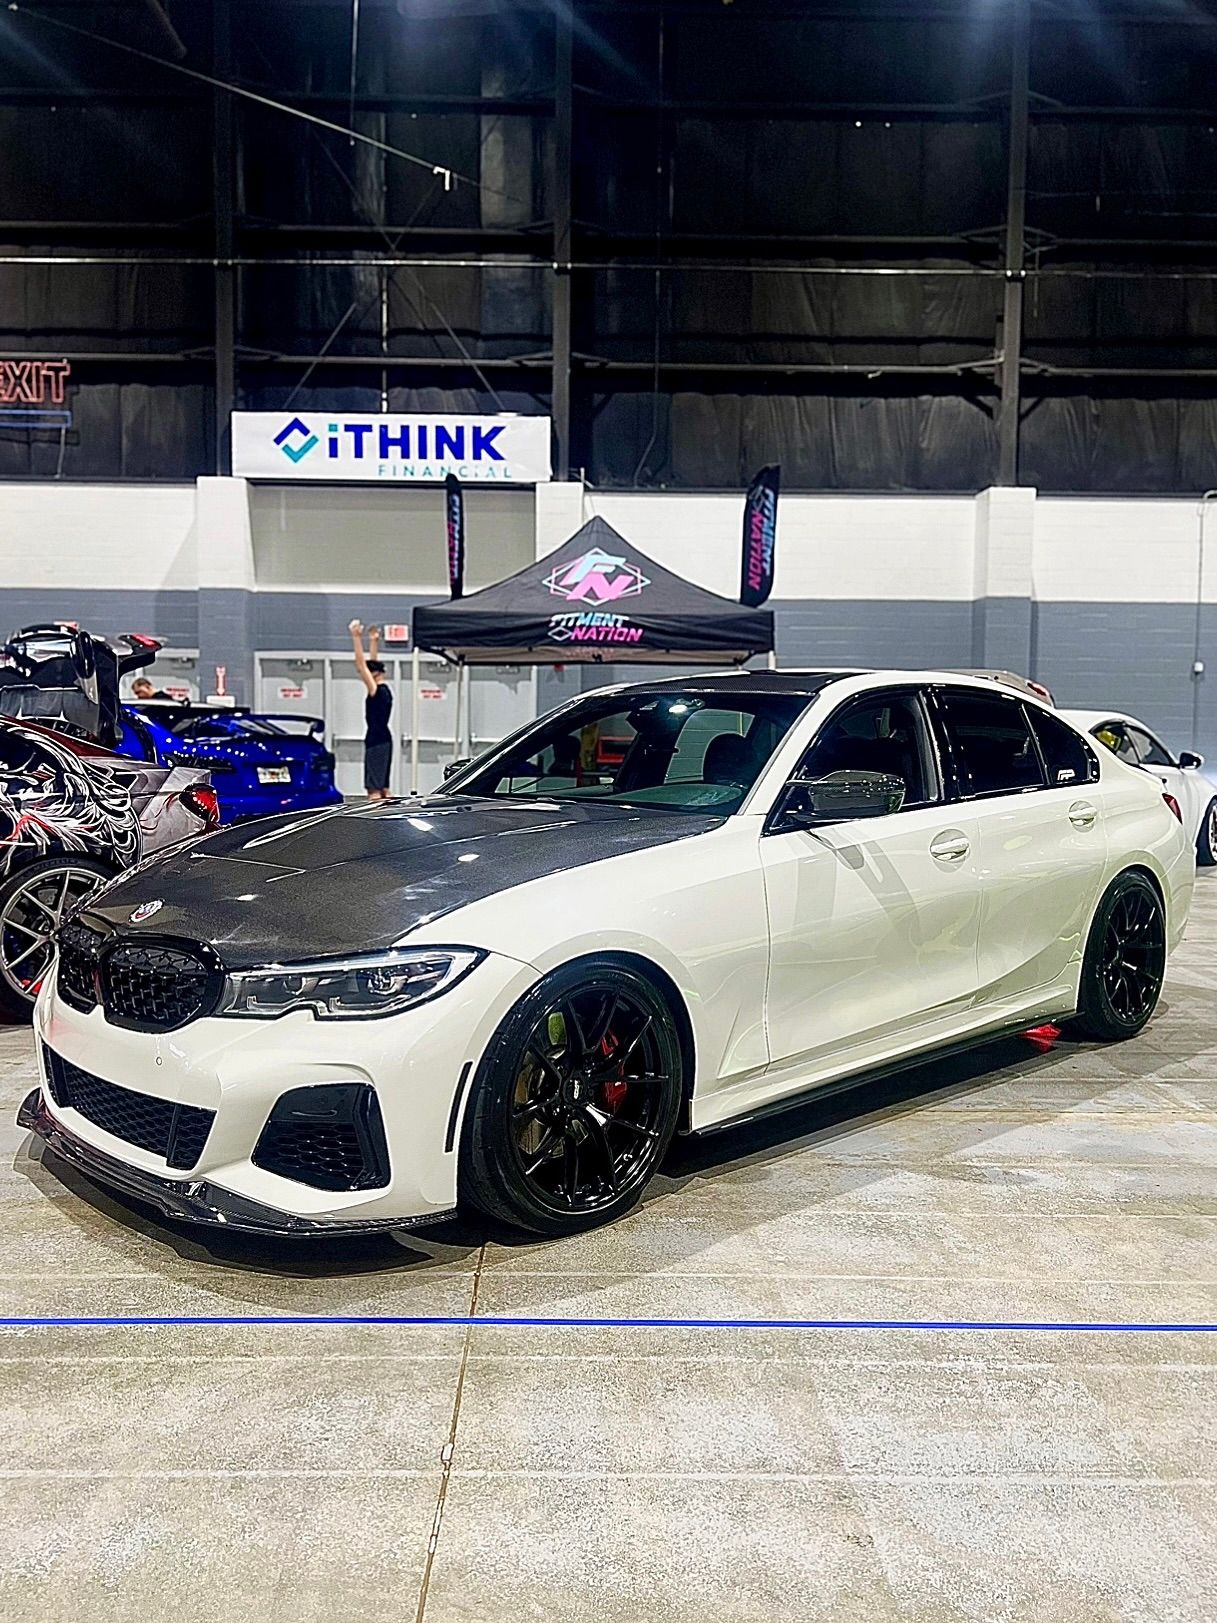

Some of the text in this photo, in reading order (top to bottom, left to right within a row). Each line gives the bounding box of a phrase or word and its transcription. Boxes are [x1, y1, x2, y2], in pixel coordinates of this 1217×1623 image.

[0, 361, 70, 402] XIT
[328, 423, 507, 461] iTHINK
[378, 465, 512, 478] FINANCIAL
[749, 509, 763, 591] NATION
[762, 488, 774, 576] FITMENT
[549, 613, 630, 628] FITMENT
[570, 626, 643, 642] NATION
